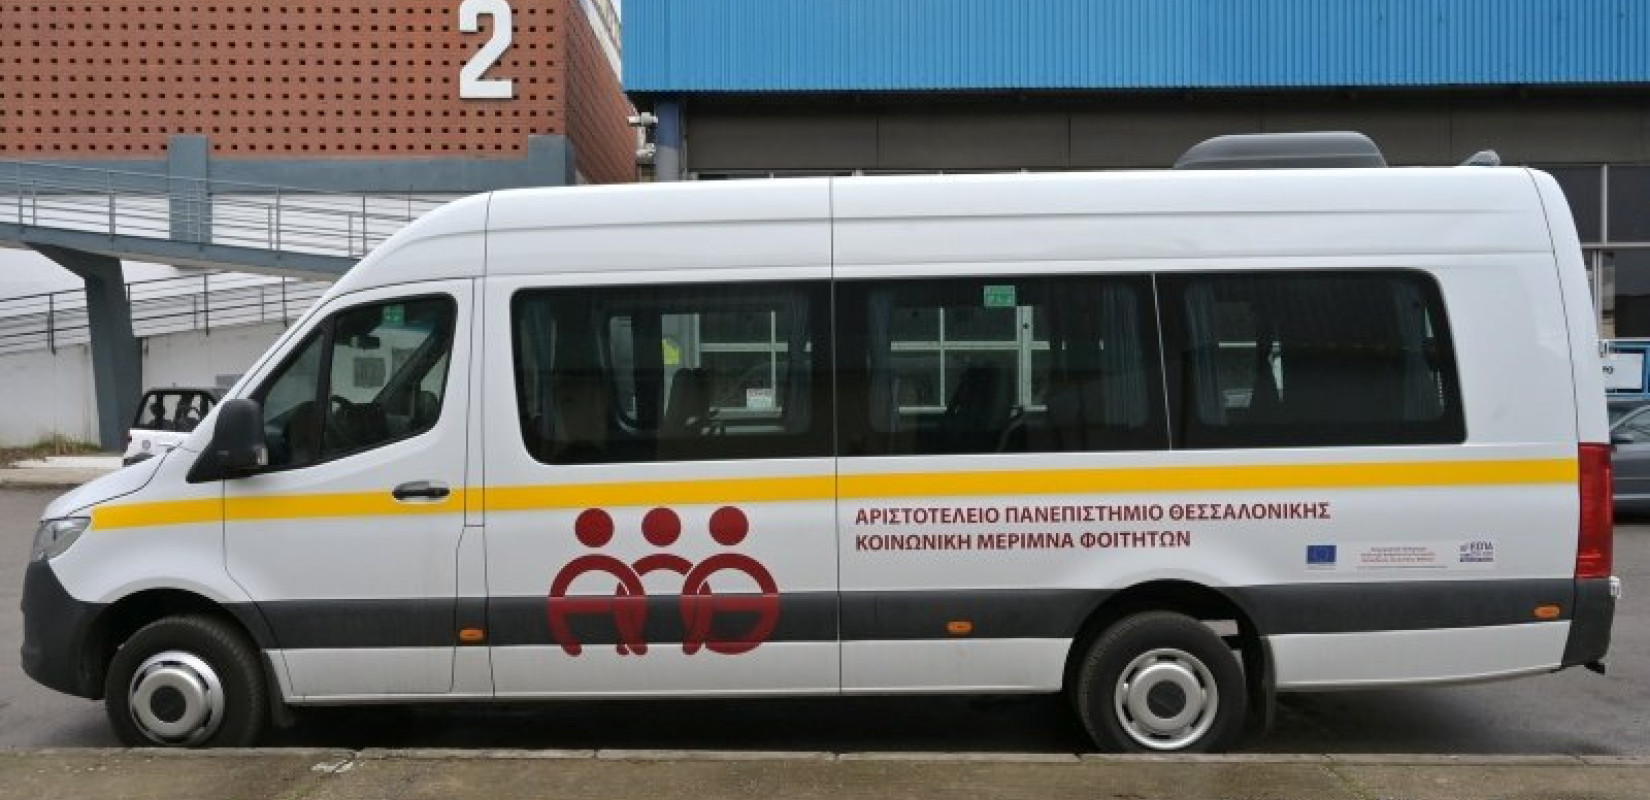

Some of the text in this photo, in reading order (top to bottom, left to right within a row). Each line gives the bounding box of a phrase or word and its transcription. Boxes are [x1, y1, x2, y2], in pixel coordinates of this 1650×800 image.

[459, 0, 512, 98] 2
[855, 503, 1331, 525] ΑΡΙΣΤΟΤΕΛΕΙΟ ΠΑΝΕΠΙΣΤΗΜΙΟ ΘΕΣΣΑΛΟΝΙΚΗΣ
[855, 530, 1192, 551] ΚΟΙΝΩΝΙΚΗ ΜΕΡΙΜΝΑ ΦΟΙΤΗΤΩΝ
